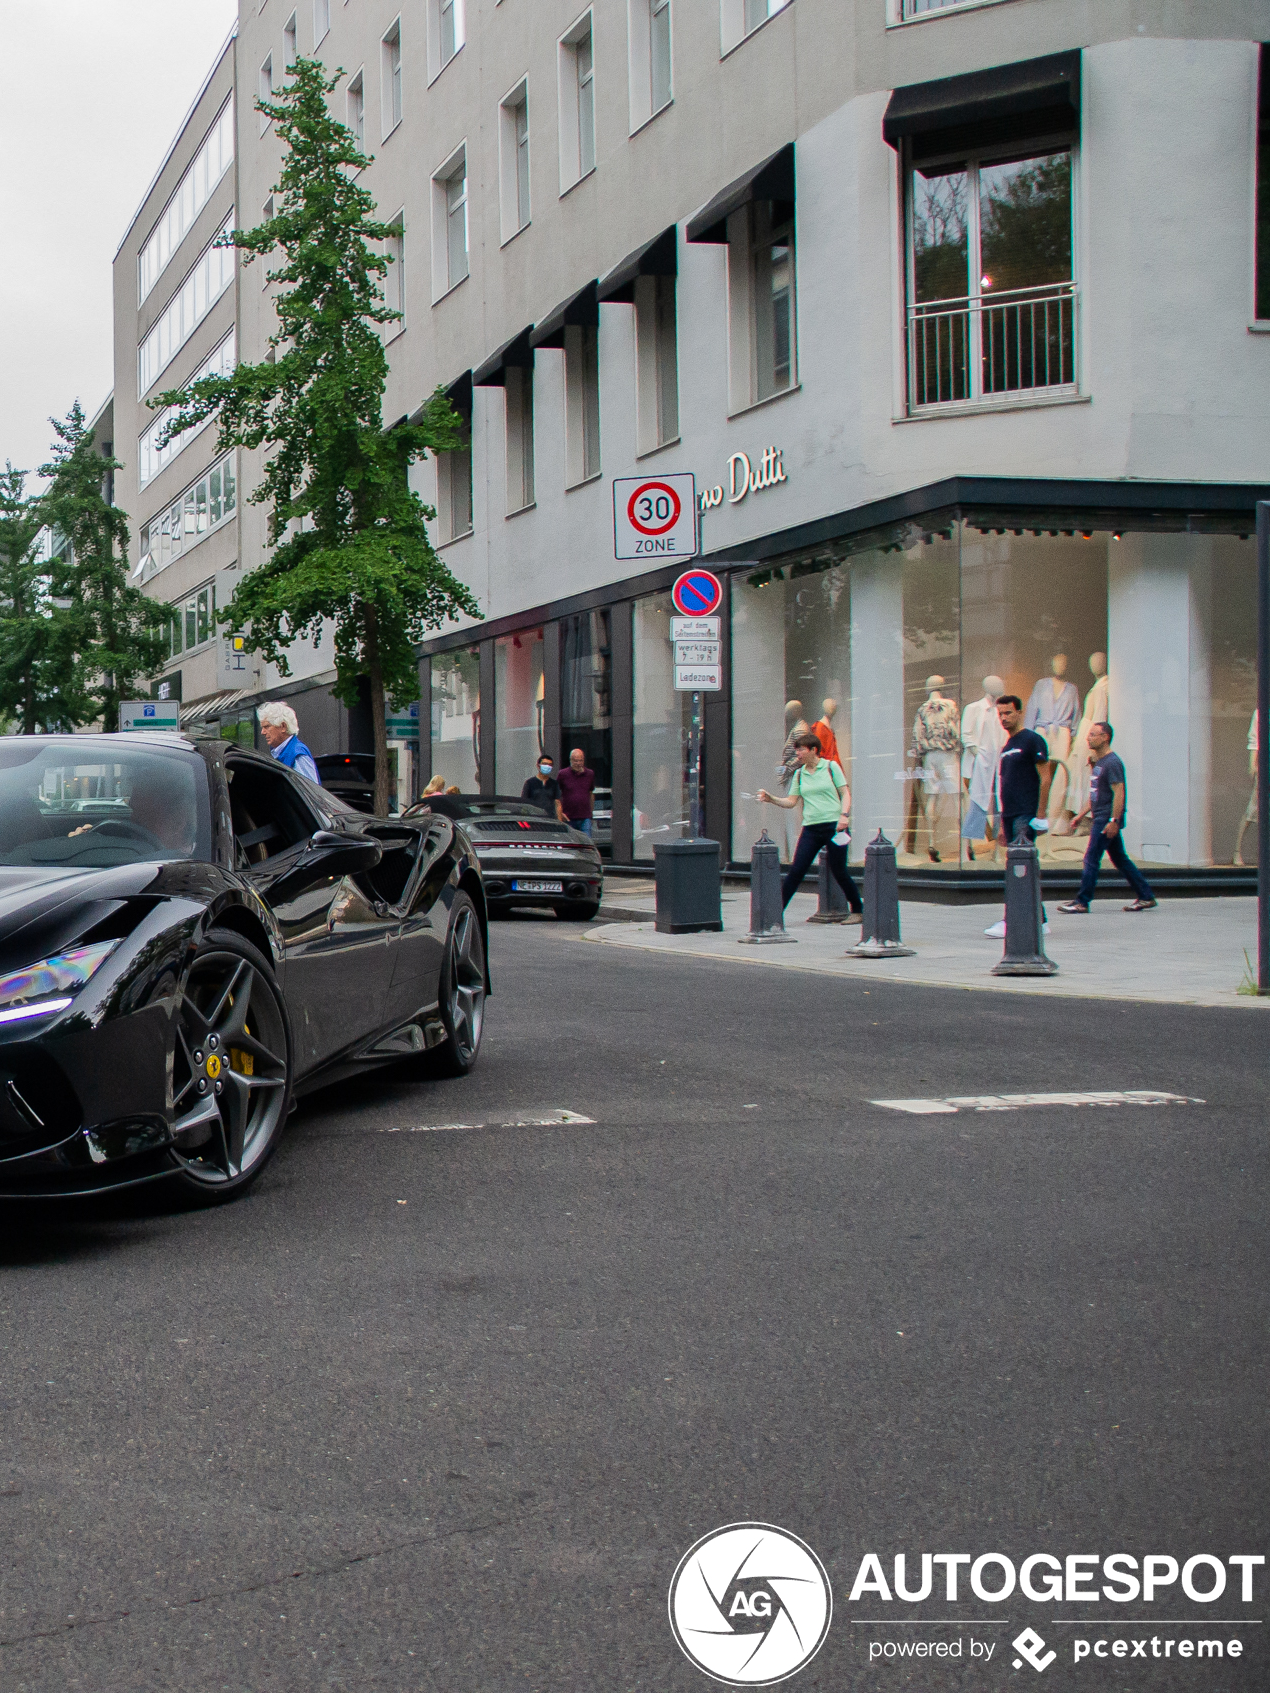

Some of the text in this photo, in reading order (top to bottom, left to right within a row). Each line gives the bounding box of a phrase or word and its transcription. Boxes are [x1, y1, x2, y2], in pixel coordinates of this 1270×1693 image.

[726, 445, 787, 503] Dutti
[638, 496, 670, 521] 30
[635, 538, 676, 553] ZONE
[678, 644, 717, 653] werktags
